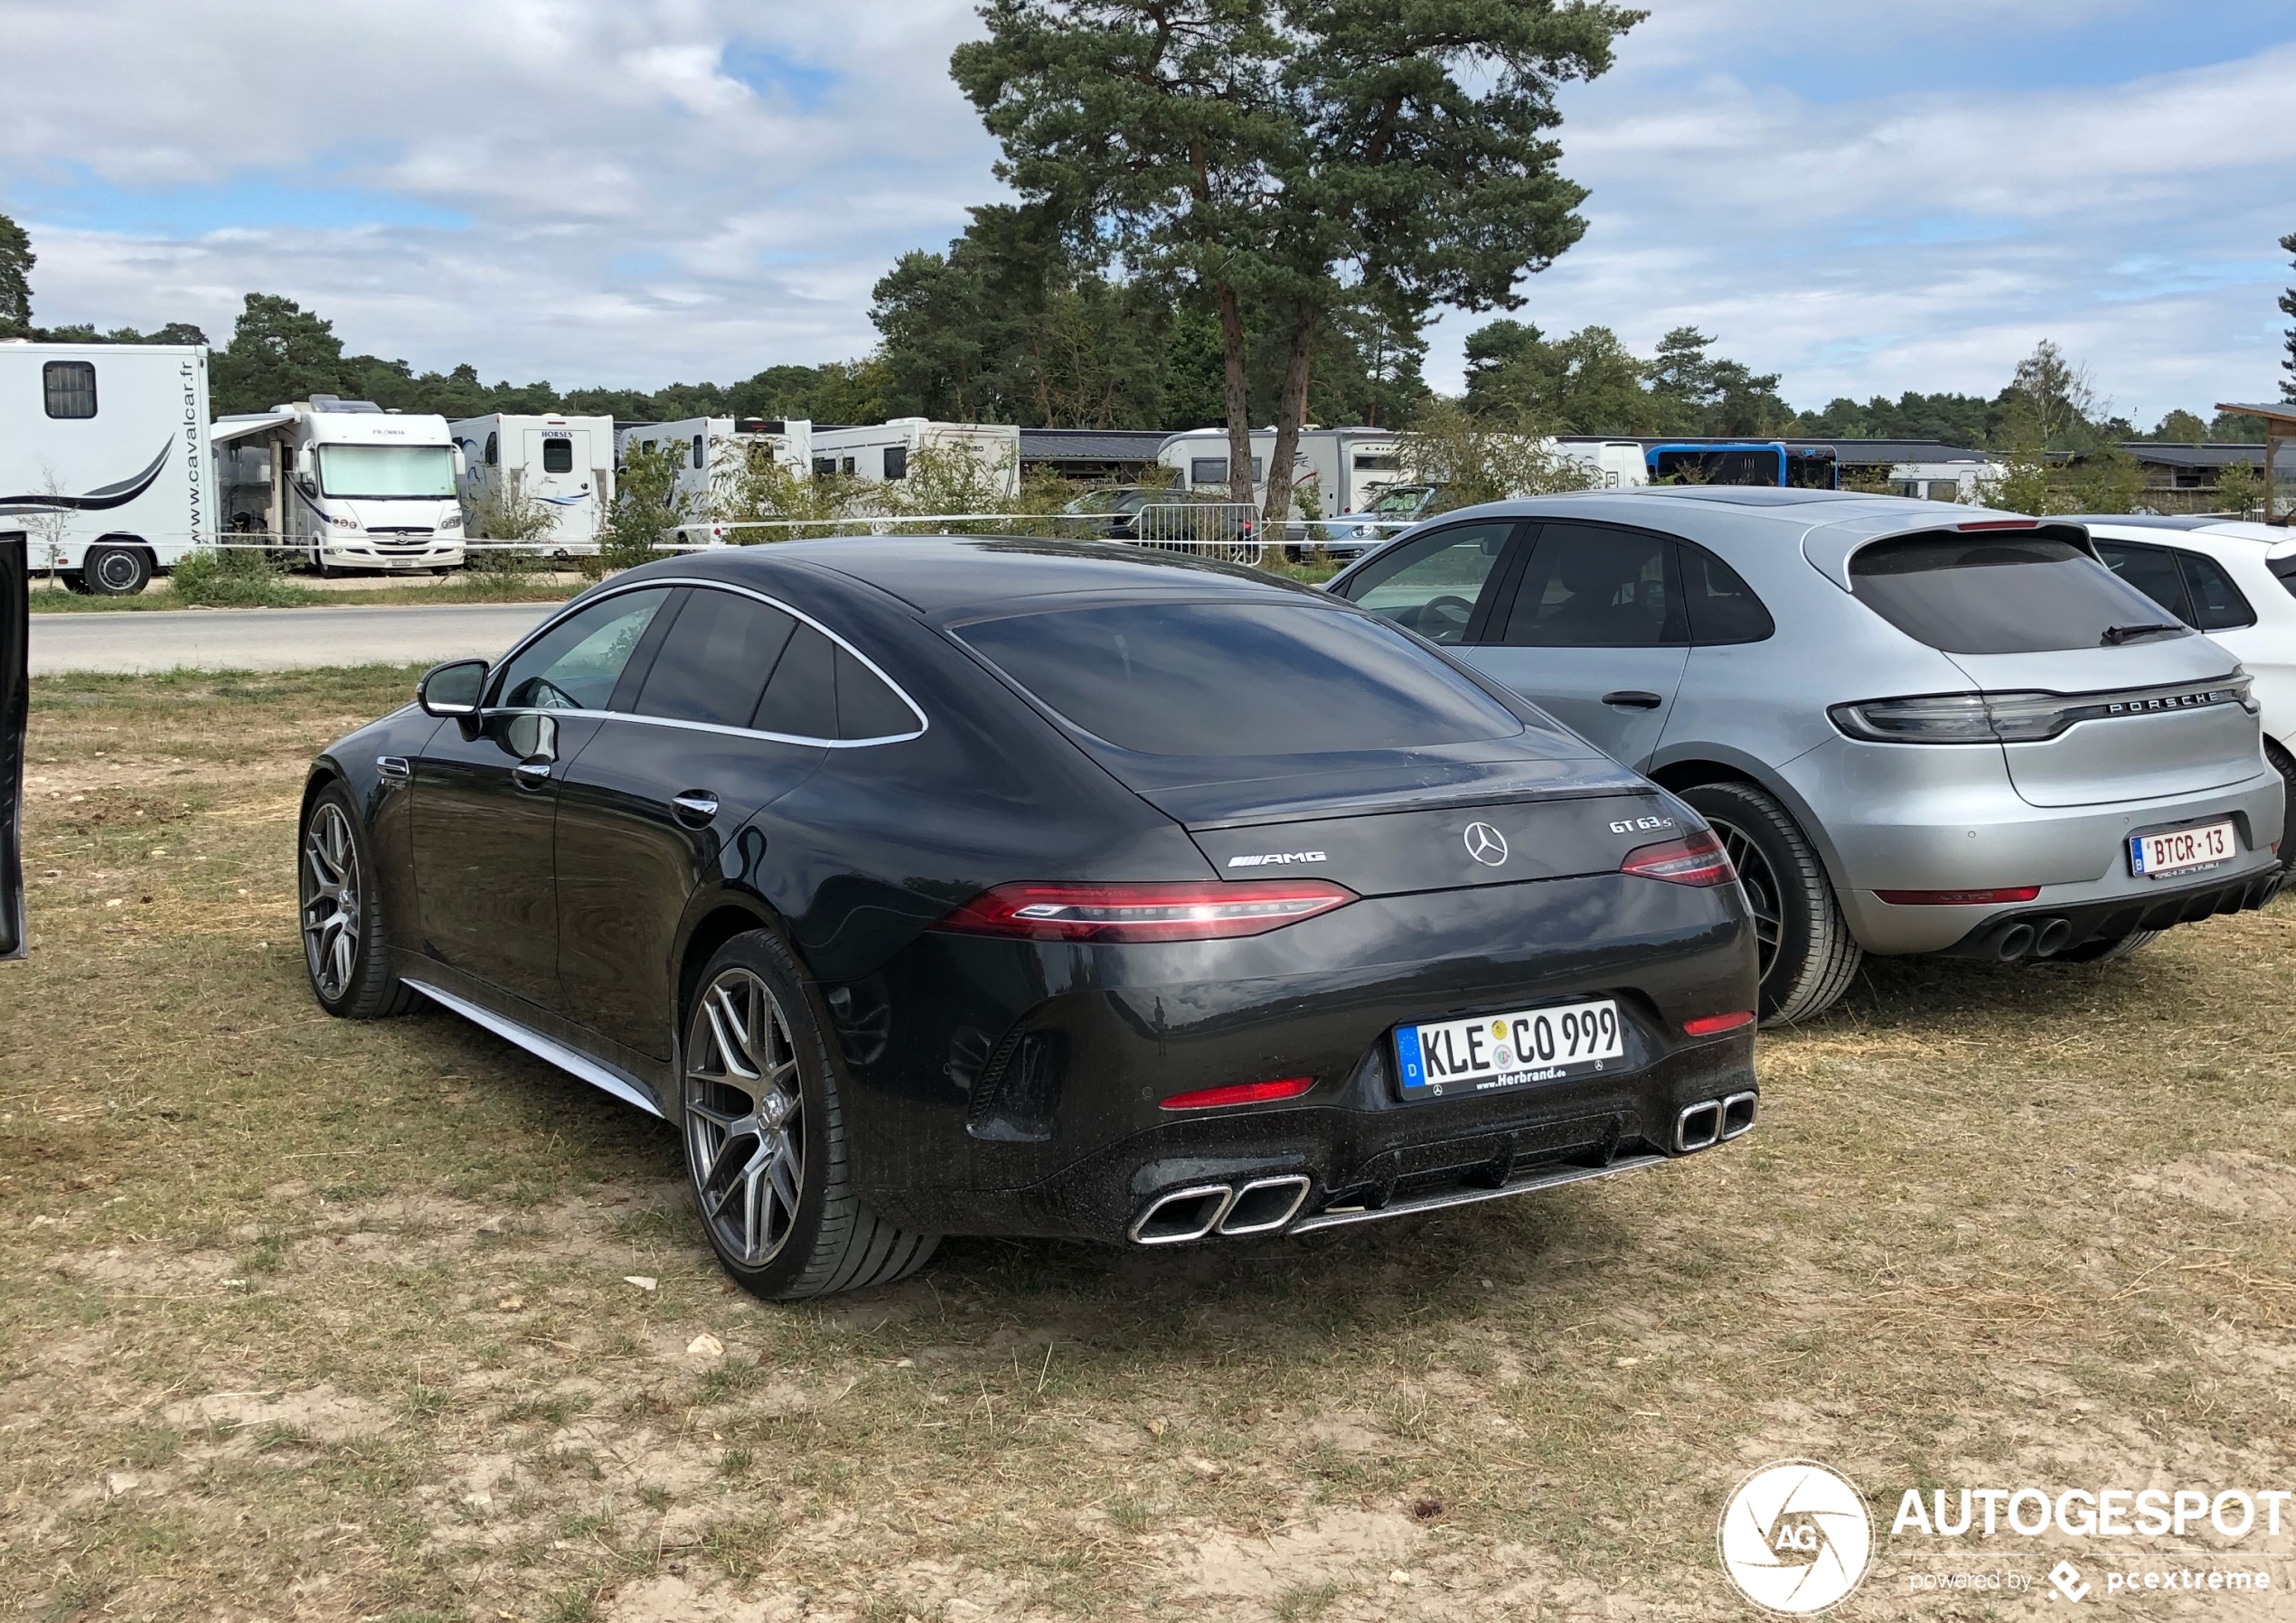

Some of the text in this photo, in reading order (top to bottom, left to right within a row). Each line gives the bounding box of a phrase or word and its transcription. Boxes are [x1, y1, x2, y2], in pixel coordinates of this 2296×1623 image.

[180, 361, 202, 545] www.cavalcar.fr
[2109, 691, 2219, 714] PORSCHE
[1609, 819, 1634, 834] GT
[1260, 850, 1327, 866] AMG
[2135, 858, 2143, 871] B
[1407, 1007, 1617, 1077] D KLE CO 999
[1476, 1067, 1567, 1090] www.Herbrand.de
